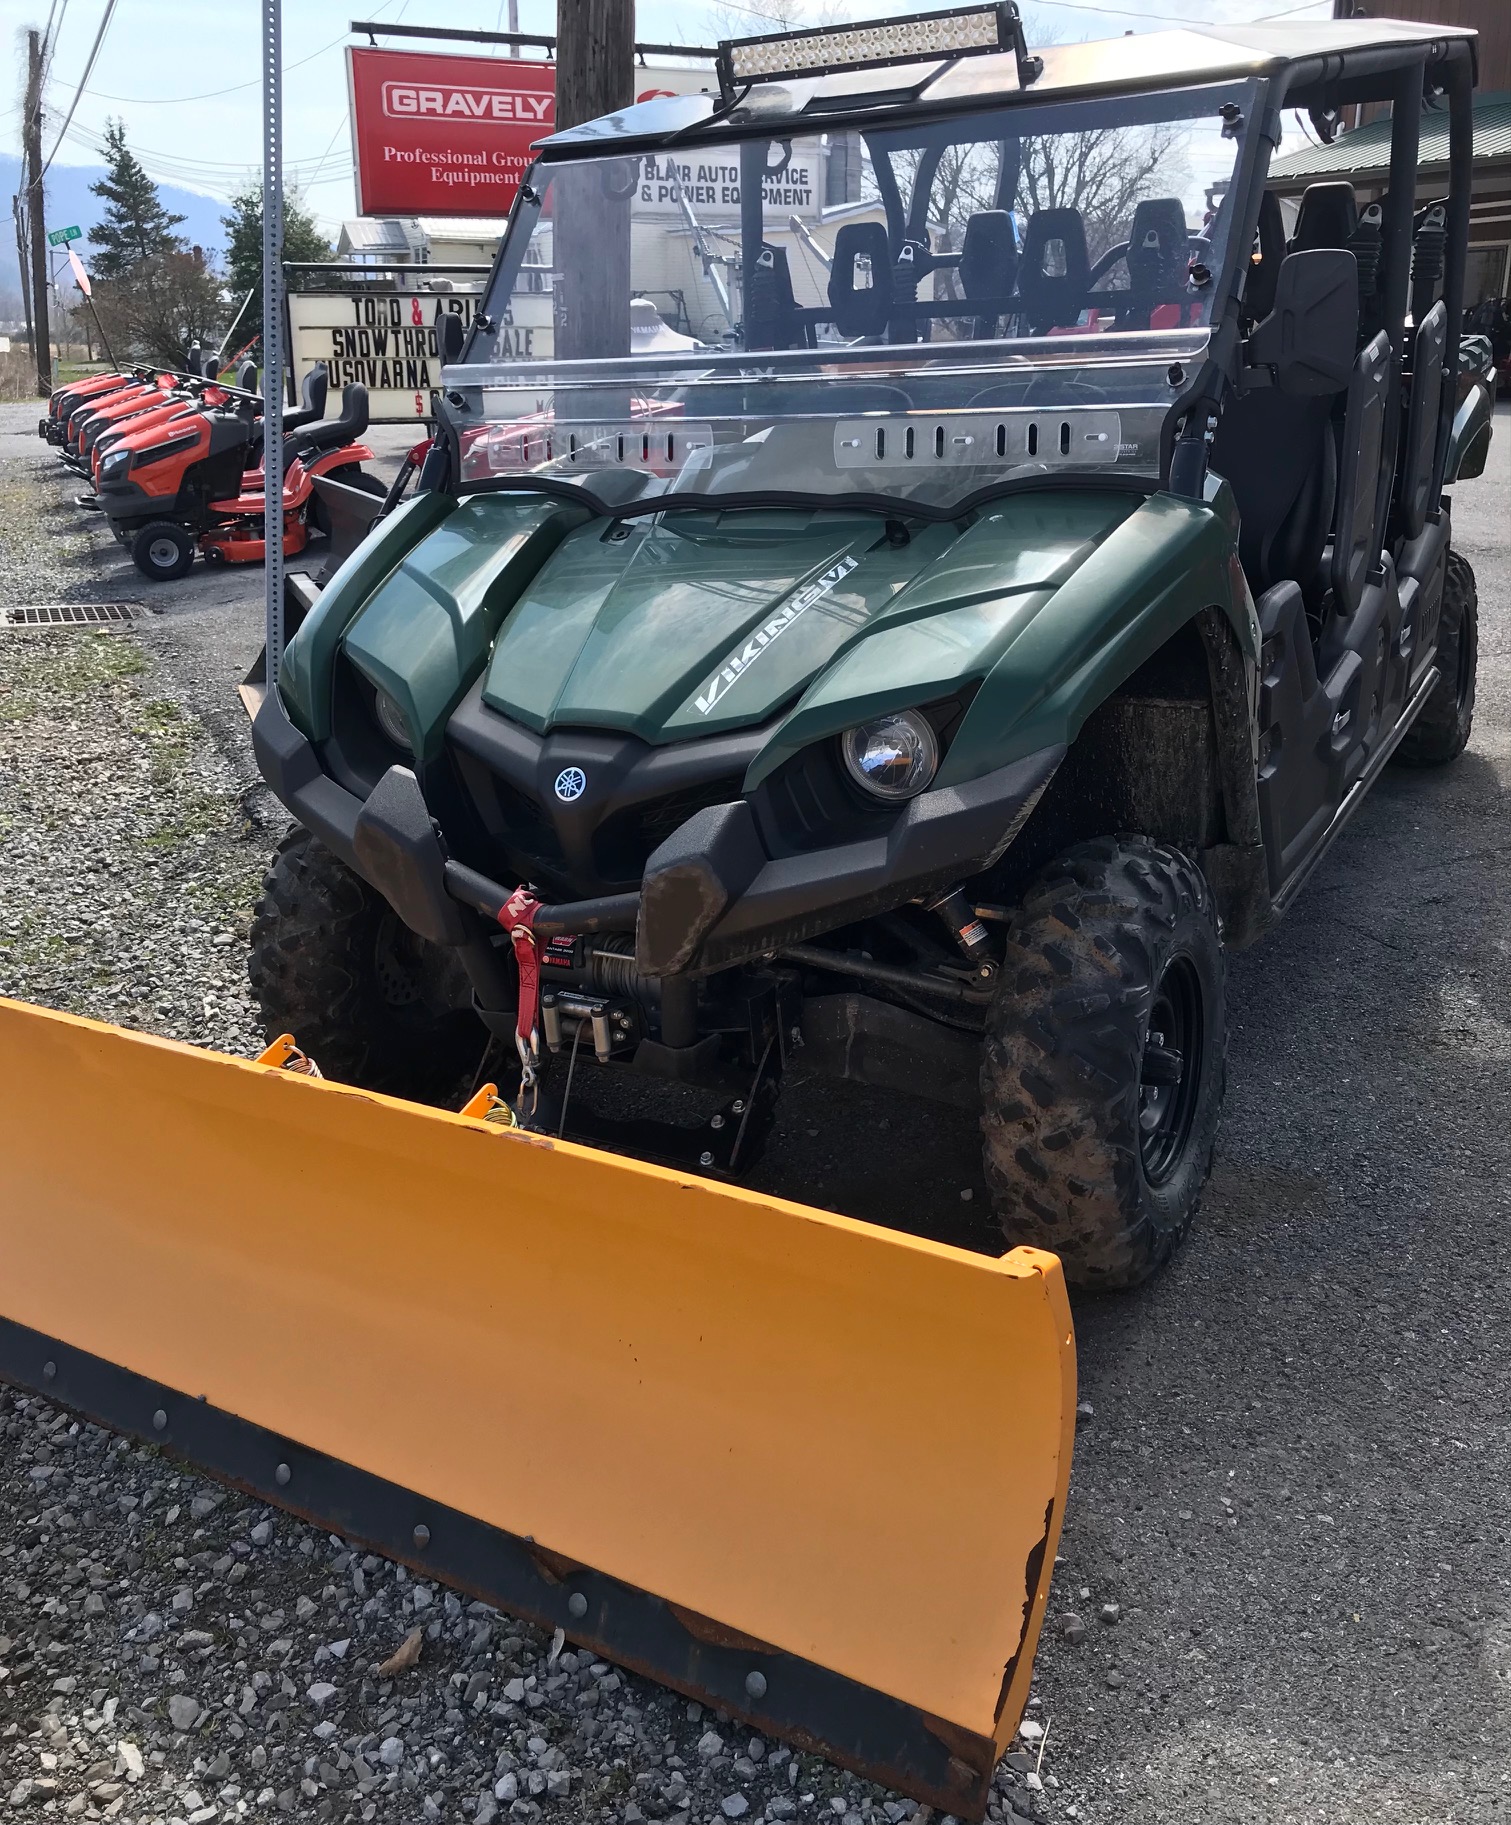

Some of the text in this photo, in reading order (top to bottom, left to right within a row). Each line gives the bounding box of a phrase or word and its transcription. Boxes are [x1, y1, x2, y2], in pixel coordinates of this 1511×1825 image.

[391, 88, 552, 120] GRAVELY
[383, 146, 536, 167] Professional Grou
[430, 166, 520, 187] Equipment
[644, 164, 691, 183] BLAIR
[697, 165, 738, 183] AUTO
[641, 184, 653, 202] &
[721, 186, 812, 206] EQPMENT
[411, 297, 423, 326] &
[694, 583, 823, 714] VIKING
